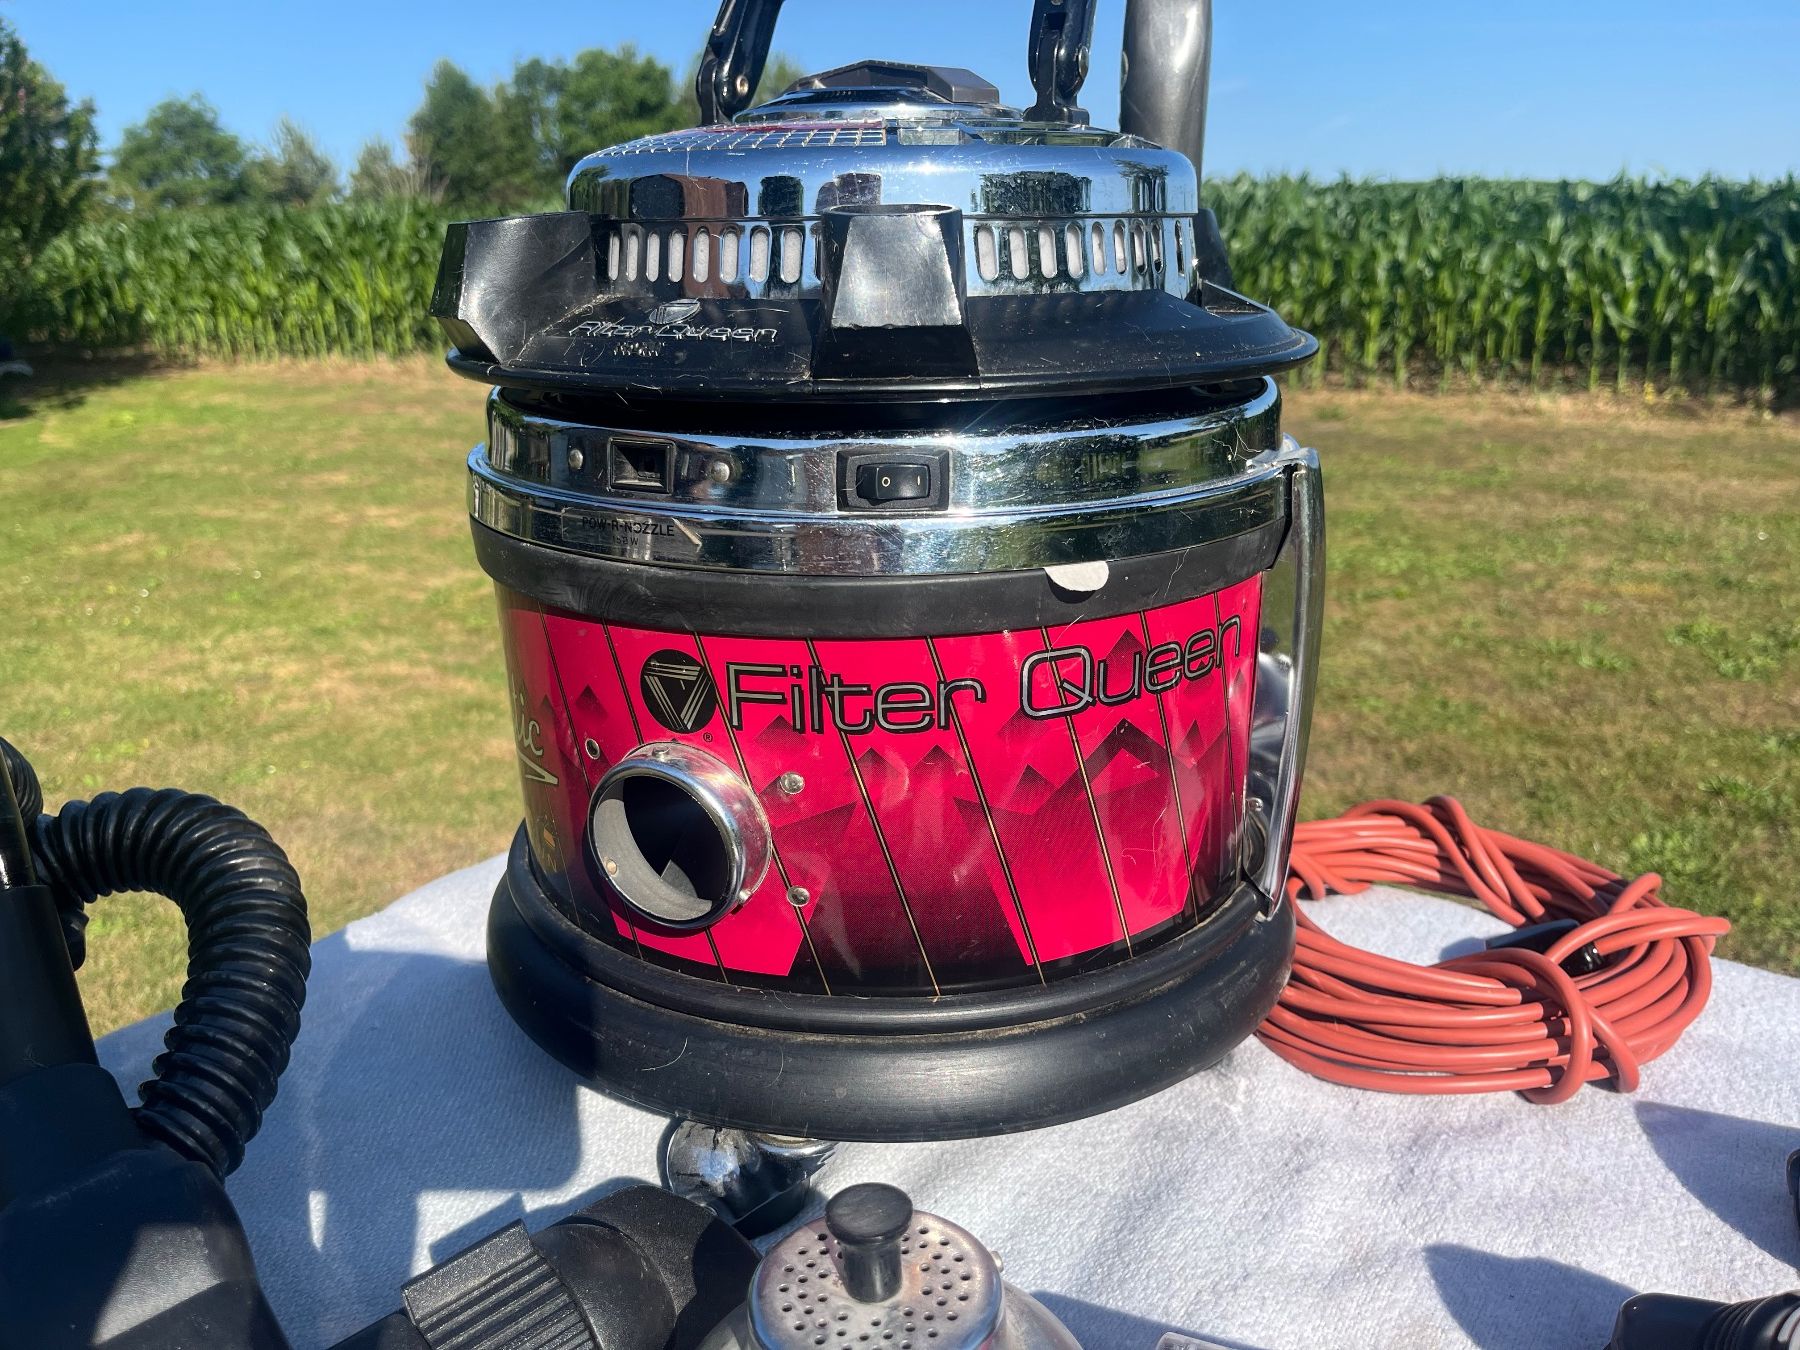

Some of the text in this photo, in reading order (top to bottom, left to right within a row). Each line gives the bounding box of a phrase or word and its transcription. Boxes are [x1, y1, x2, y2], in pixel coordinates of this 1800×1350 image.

[655, 323, 779, 343] Queen
[726, 614, 1242, 735] Filter Queen
